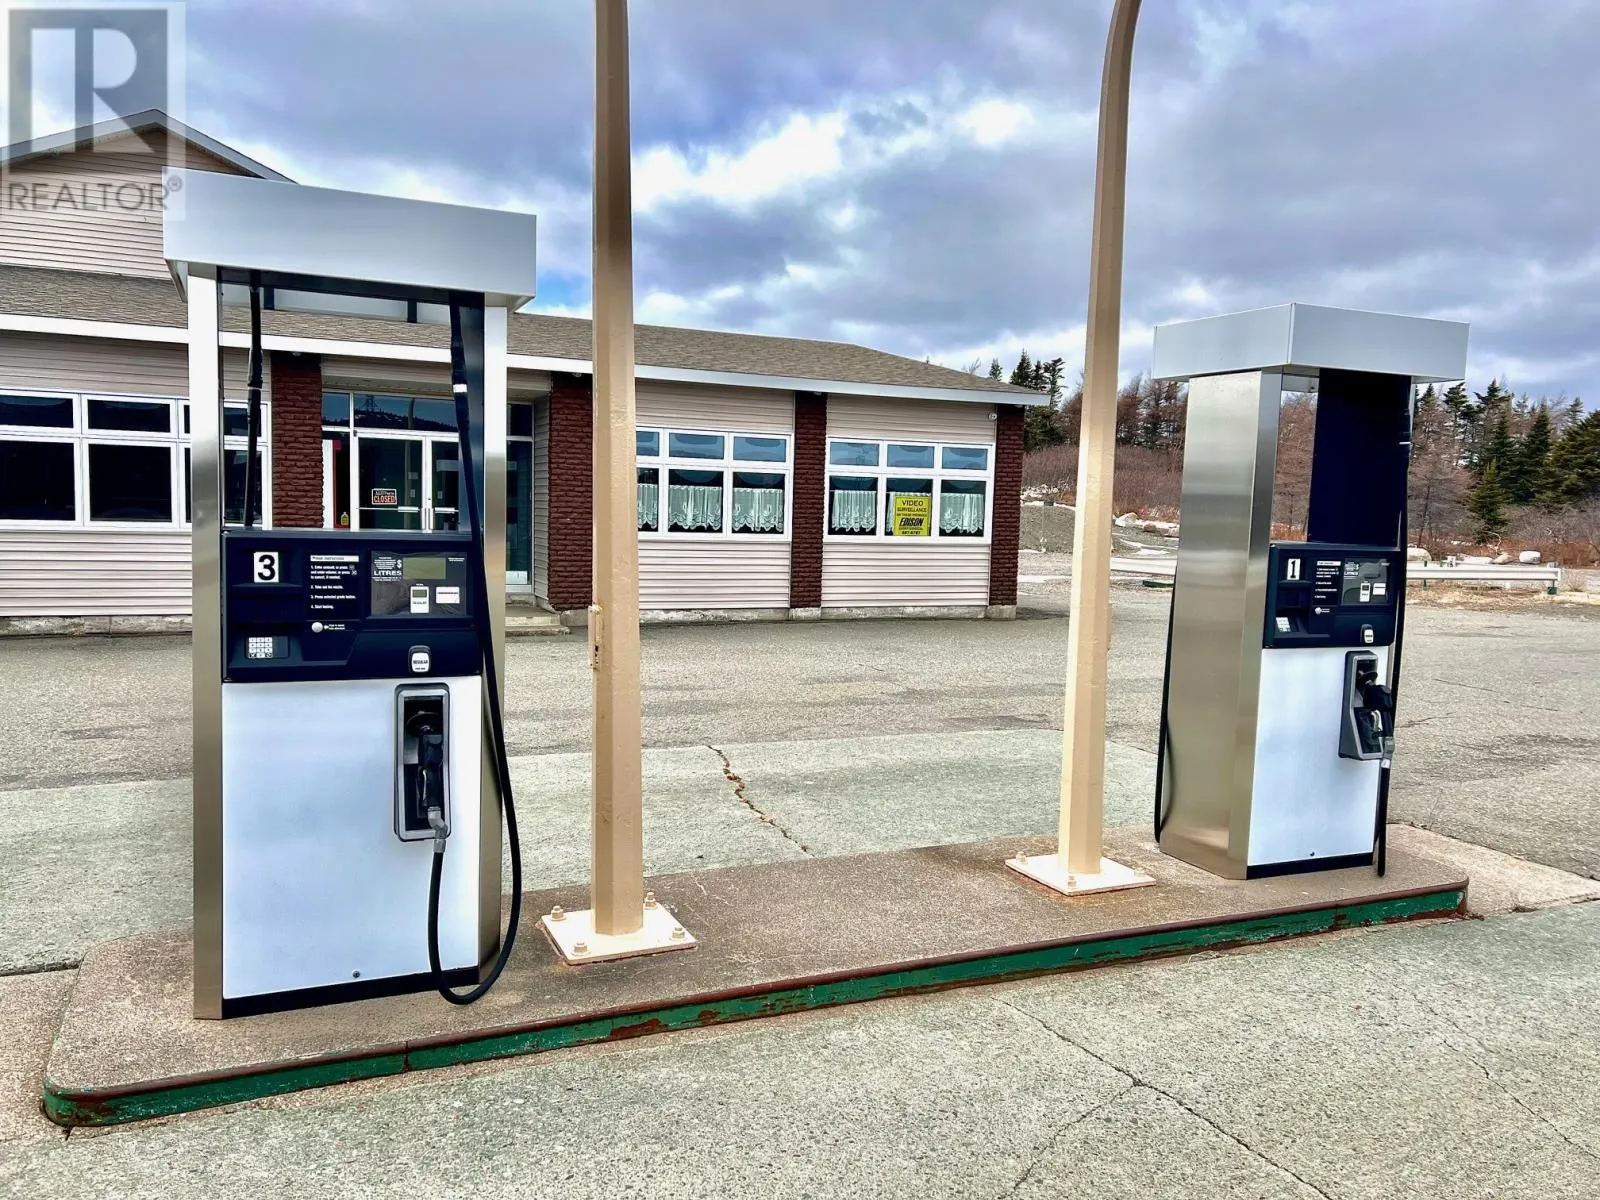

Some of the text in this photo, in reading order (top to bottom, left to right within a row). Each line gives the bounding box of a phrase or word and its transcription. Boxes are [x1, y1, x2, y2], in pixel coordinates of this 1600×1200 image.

[899, 518, 924, 526] EDISON
[257, 554, 276, 581] 3
[396, 560, 402, 569] $
[1290, 560, 1297, 578] 1
